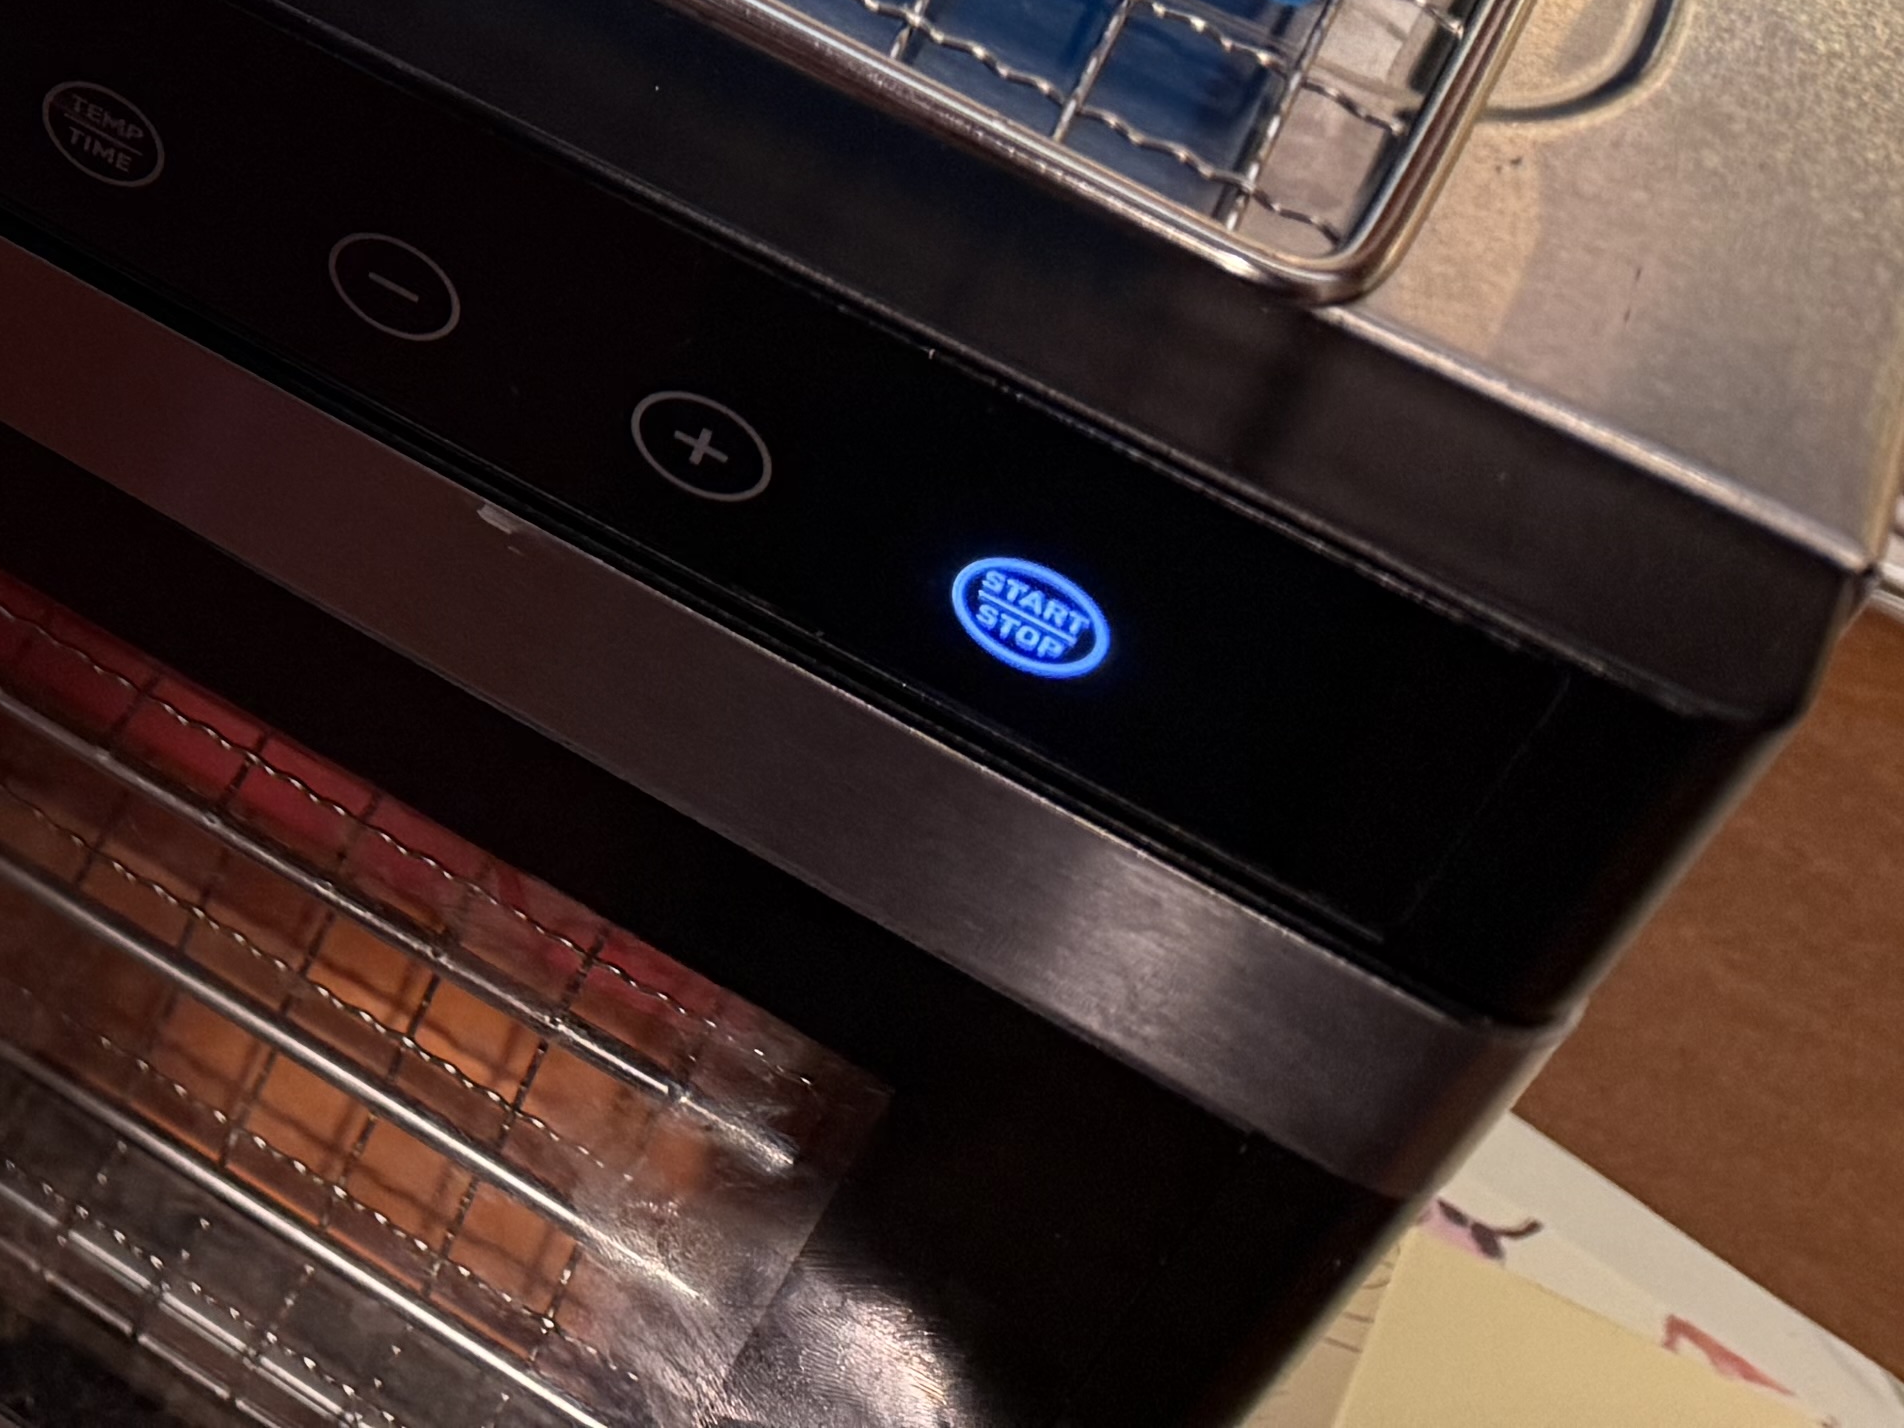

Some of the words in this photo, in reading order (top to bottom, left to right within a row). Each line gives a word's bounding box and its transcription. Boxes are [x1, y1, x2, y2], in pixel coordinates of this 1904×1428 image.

[72, 93, 144, 139] TEMP
[69, 126, 132, 173] TIME
[982, 570, 1090, 635] START
[976, 604, 1065, 659] STOP
